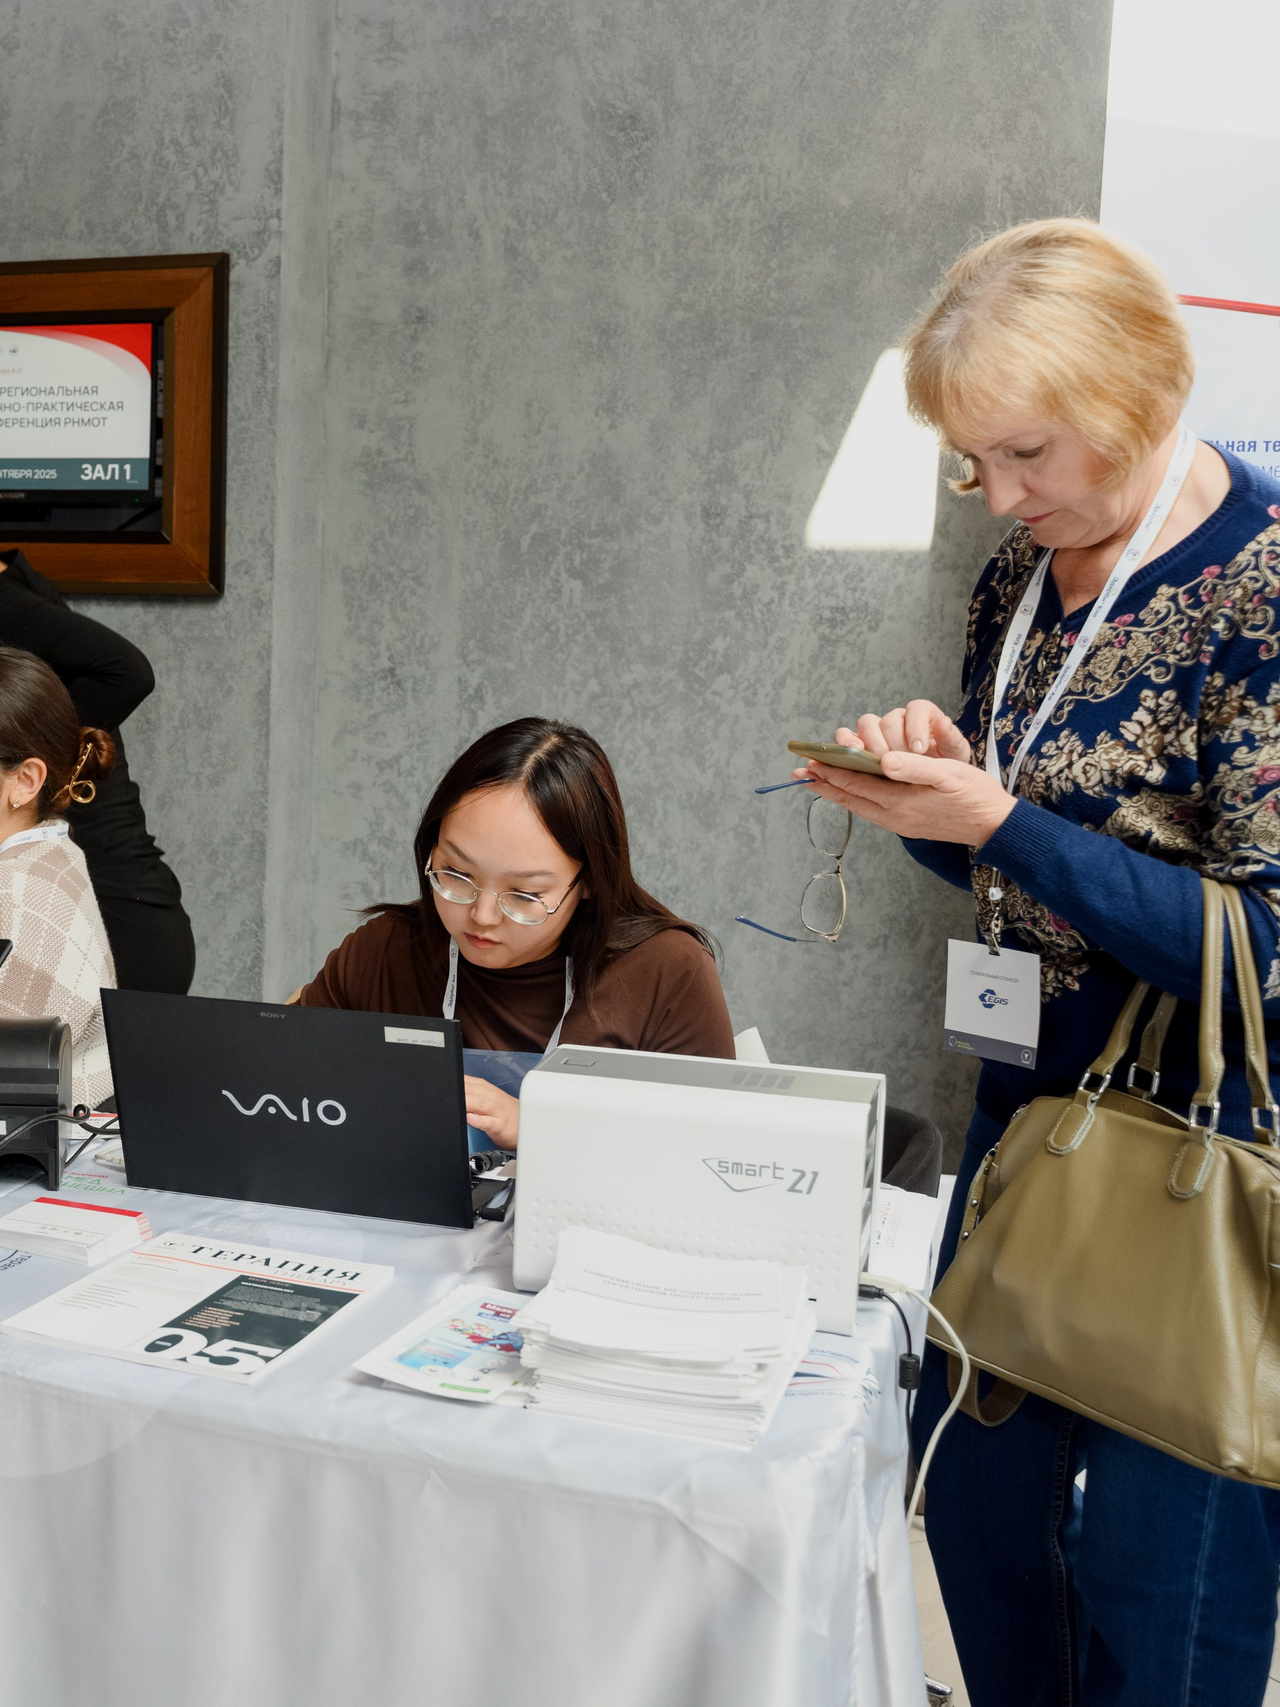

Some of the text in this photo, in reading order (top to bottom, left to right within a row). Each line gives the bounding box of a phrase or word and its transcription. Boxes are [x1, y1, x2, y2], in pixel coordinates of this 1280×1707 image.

[64, 418, 108, 428] РНМОТ
[34, 469, 57, 479] 2025
[81, 464, 131, 480] ЗАЛ 1
[988, 996, 1008, 1006] EGIS
[260, 1011, 286, 1019] SONY
[222, 1089, 346, 1125] VAIO
[718, 1160, 819, 1195] smart 21
[192, 1245, 362, 1280] ТЕРАПИЯ
